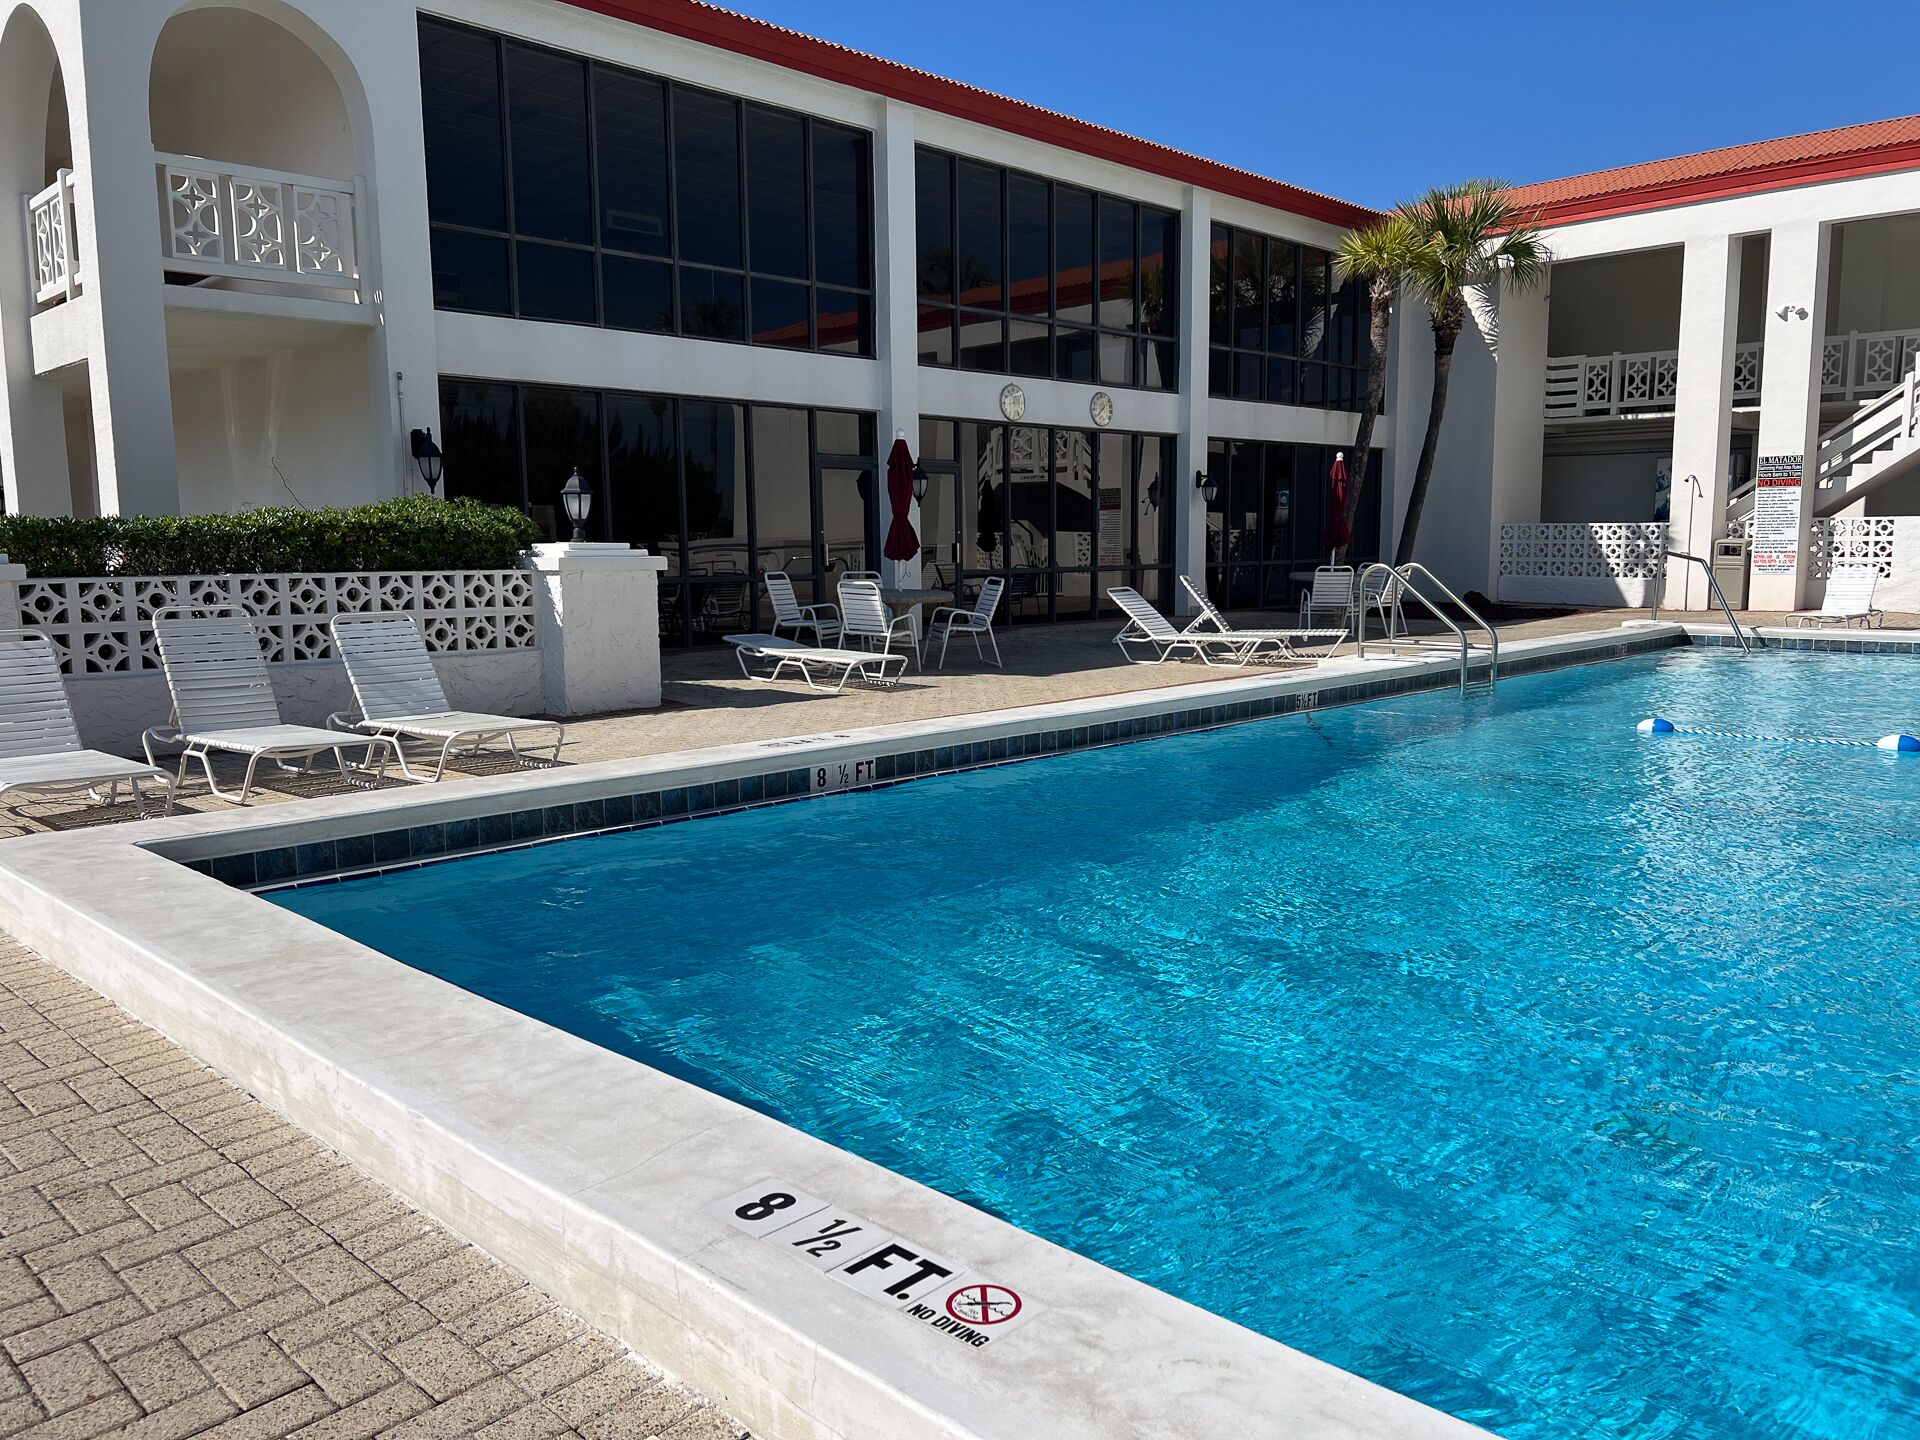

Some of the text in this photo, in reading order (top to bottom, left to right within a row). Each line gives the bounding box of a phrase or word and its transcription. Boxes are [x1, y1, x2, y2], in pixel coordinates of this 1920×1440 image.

[1769, 455, 1802, 464] MATADOR
[1758, 478, 1801, 487] NO DIVING
[817, 767, 827, 788] 8
[735, 1192, 797, 1220] 8
[842, 1243, 954, 1300] FT.
[907, 1303, 990, 1349] NO DIVING
